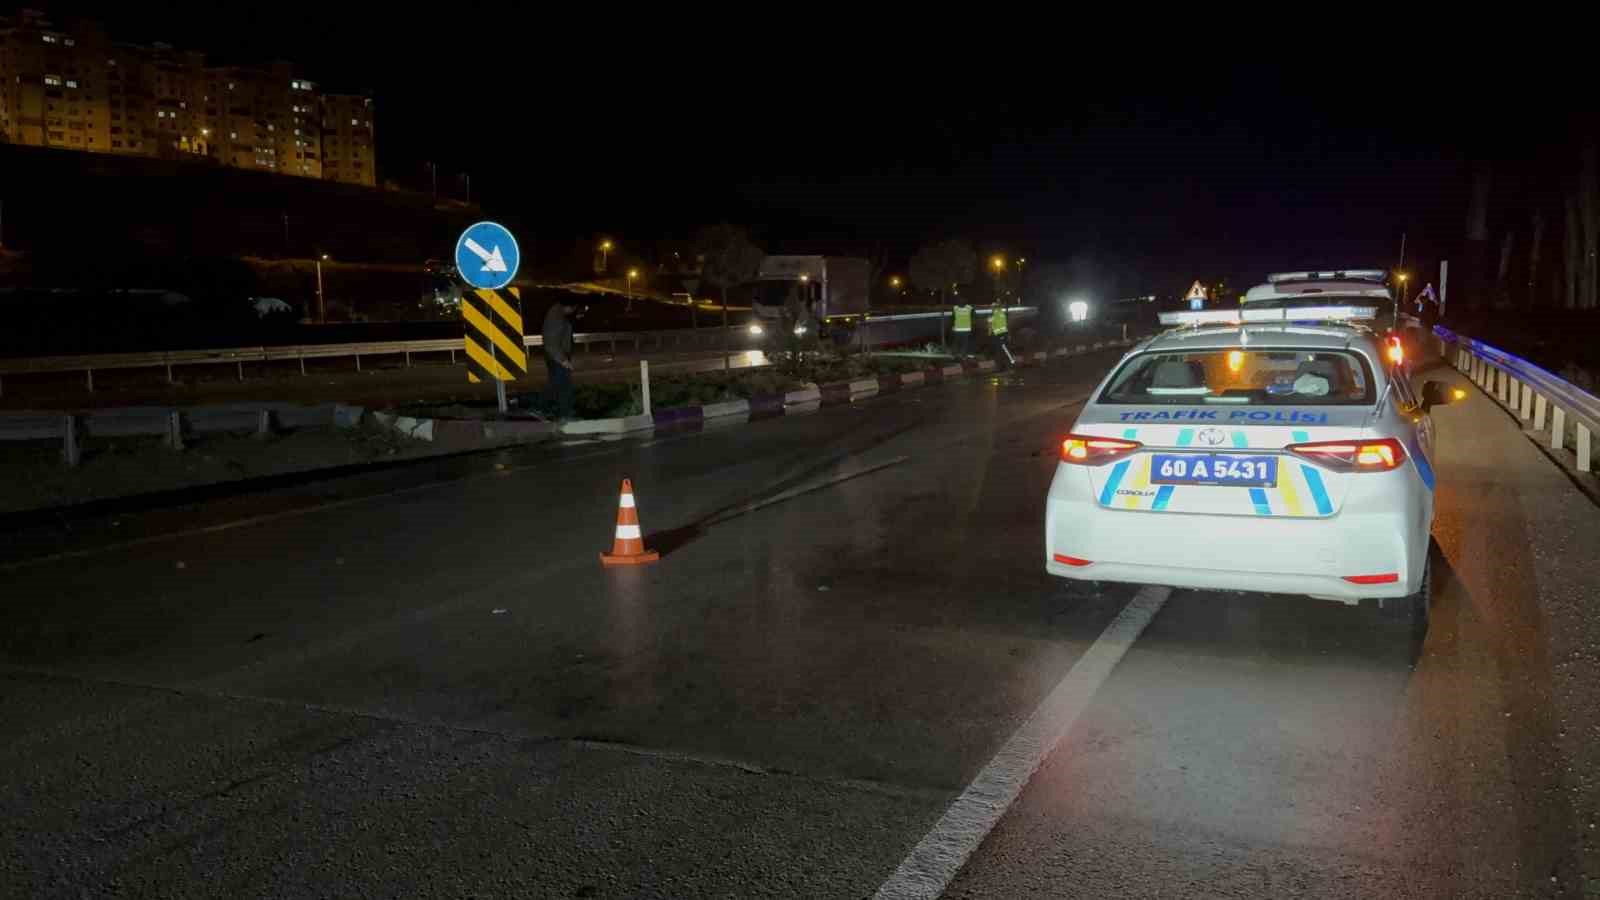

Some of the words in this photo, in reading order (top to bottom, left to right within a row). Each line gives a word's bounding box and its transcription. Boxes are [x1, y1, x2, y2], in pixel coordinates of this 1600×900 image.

[1160, 459, 1187, 477] 60
[1191, 460, 1209, 478] A
[1214, 460, 1268, 480] 5431
